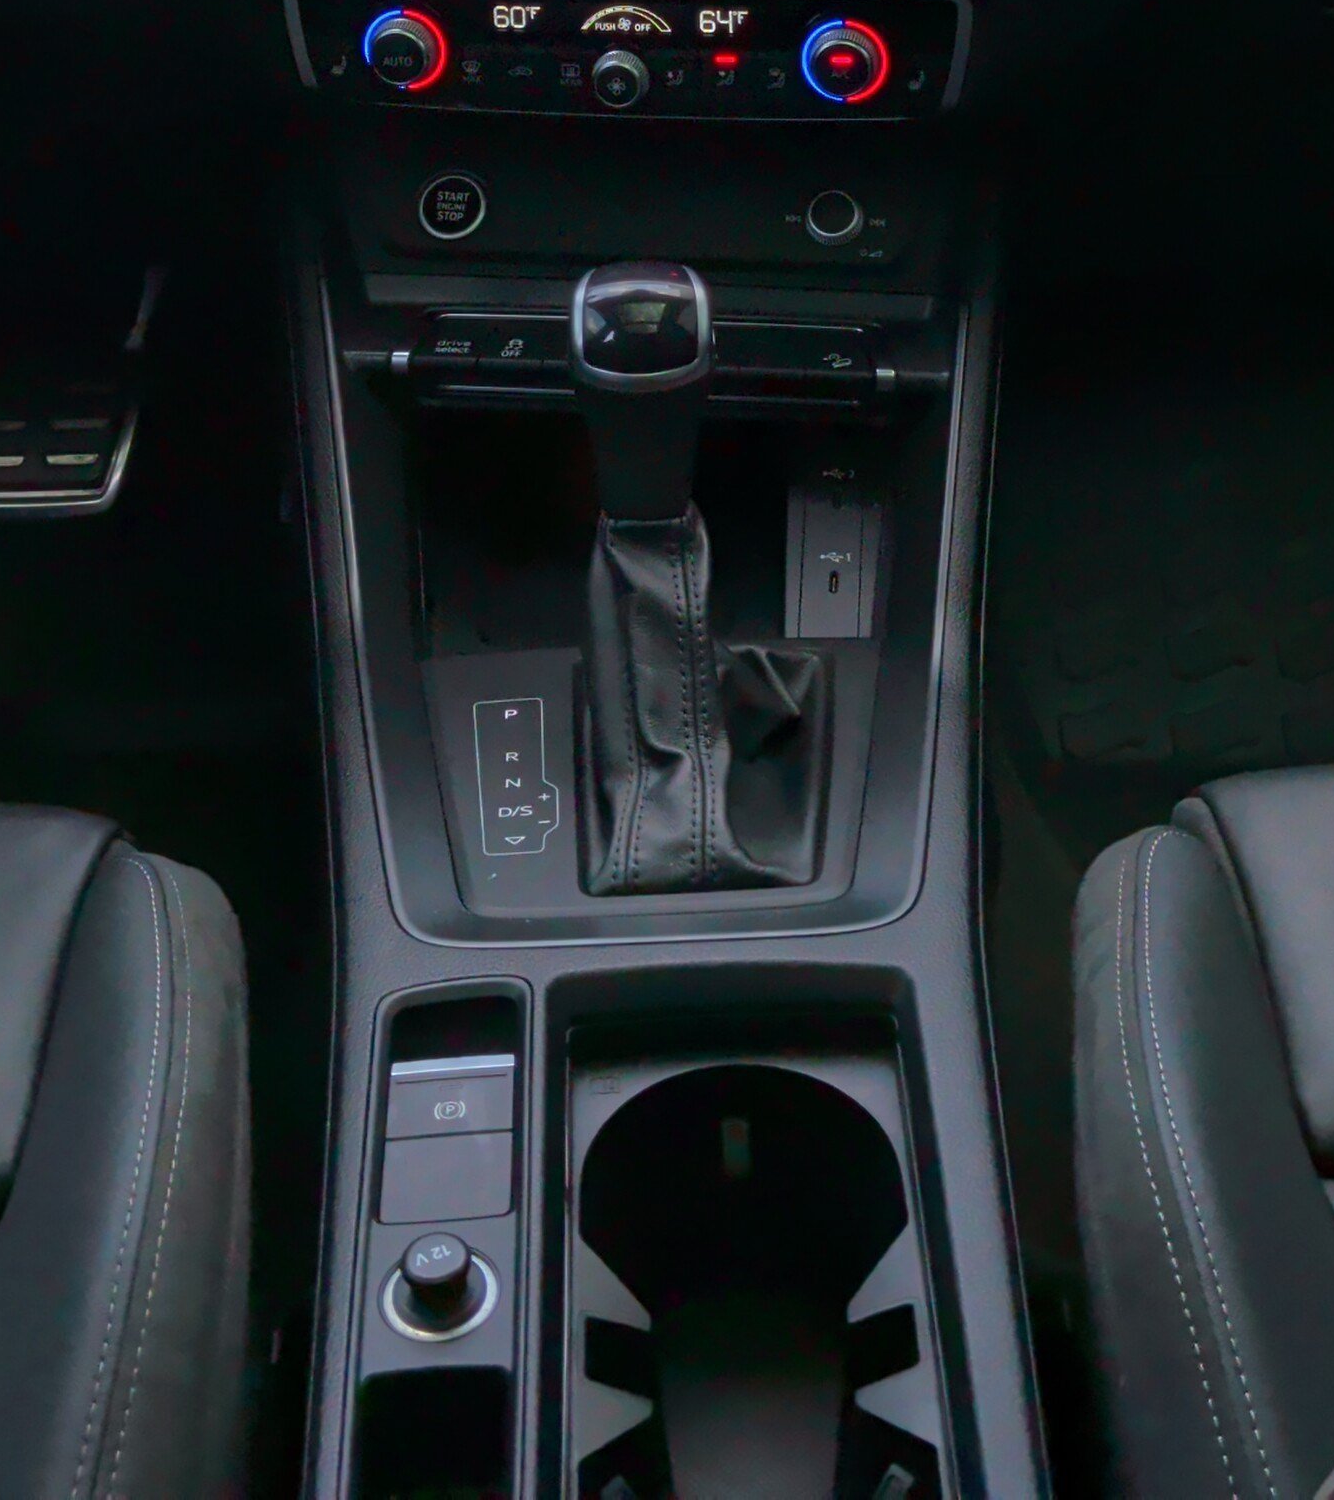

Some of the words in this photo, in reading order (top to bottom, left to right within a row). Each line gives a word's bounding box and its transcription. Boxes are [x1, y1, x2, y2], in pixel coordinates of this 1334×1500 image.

[595, 22, 616, 31] PUSH
[634, 23, 652, 32] OFF
[381, 56, 414, 67] AUTO
[437, 191, 471, 202] START
[436, 211, 464, 221] STOP
[437, 339, 472, 347] drive
[504, 709, 518, 720] P
[505, 751, 519, 762] R
[505, 778, 521, 789] N
[498, 805, 533, 818] D/S
[430, 1244, 452, 1260] 12
[416, 1252, 429, 1266] V
